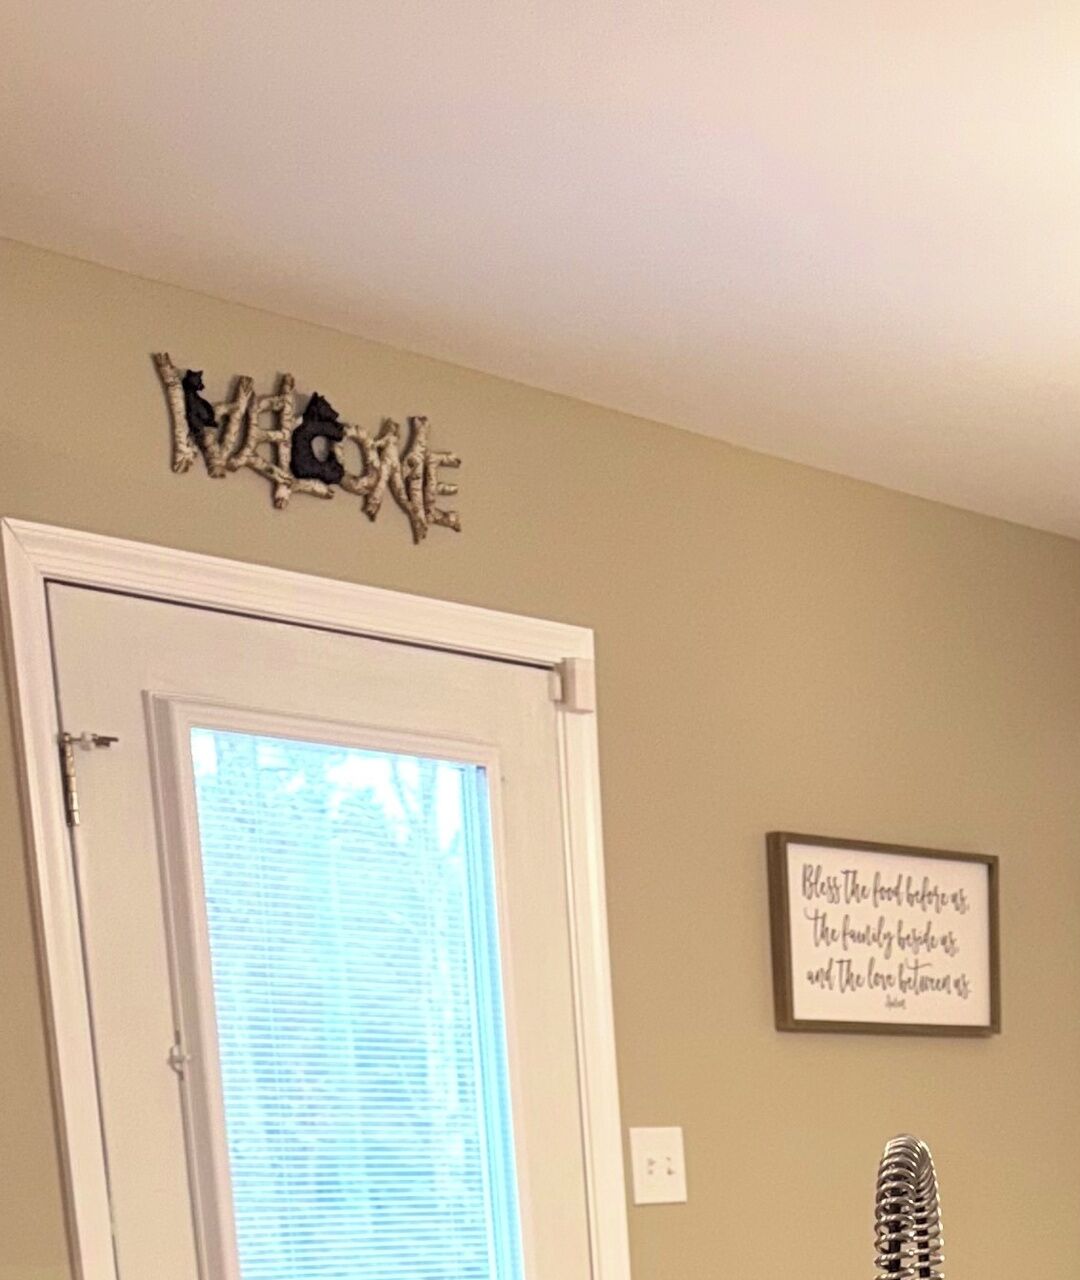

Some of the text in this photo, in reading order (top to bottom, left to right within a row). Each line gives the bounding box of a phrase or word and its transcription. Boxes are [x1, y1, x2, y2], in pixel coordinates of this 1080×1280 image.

[151, 351, 462, 546] WELCOME
[801, 864, 841, 904] Bless
[872, 871, 903, 909] food
[905, 875, 948, 914] before
[803, 906, 839, 948] the
[842, 913, 894, 960] family
[897, 919, 938, 955] beside
[806, 957, 834, 991] and
[867, 956, 896, 991] love
[898, 957, 952, 995] between
